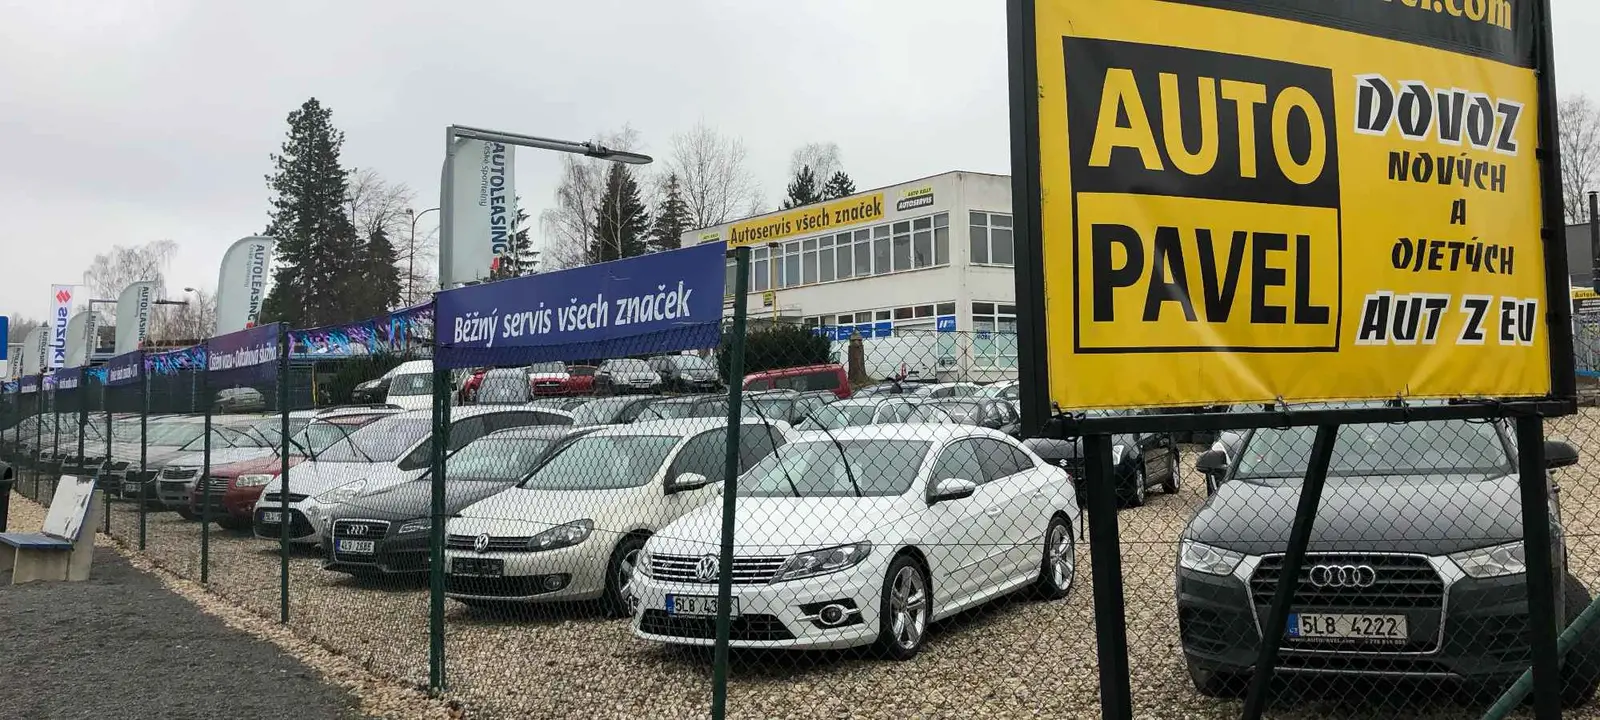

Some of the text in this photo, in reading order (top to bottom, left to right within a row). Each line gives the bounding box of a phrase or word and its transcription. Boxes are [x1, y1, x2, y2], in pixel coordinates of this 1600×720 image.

[1088, 67, 1327, 185] AUTO
[1354, 75, 1522, 154] DOVOZ
[1388, 150, 1507, 193] NOVÝCH
[730, 196, 882, 244] Autoservis všech značek
[1450, 199, 1466, 225] A
[1091, 224, 1330, 324] PAVEL
[1391, 236, 1515, 275] OJETÝCH
[454, 281, 692, 348] Běžný servis všech značek
[1356, 293, 1537, 344] AUT Z EU
[1302, 615, 1398, 636] 5L8 4222
